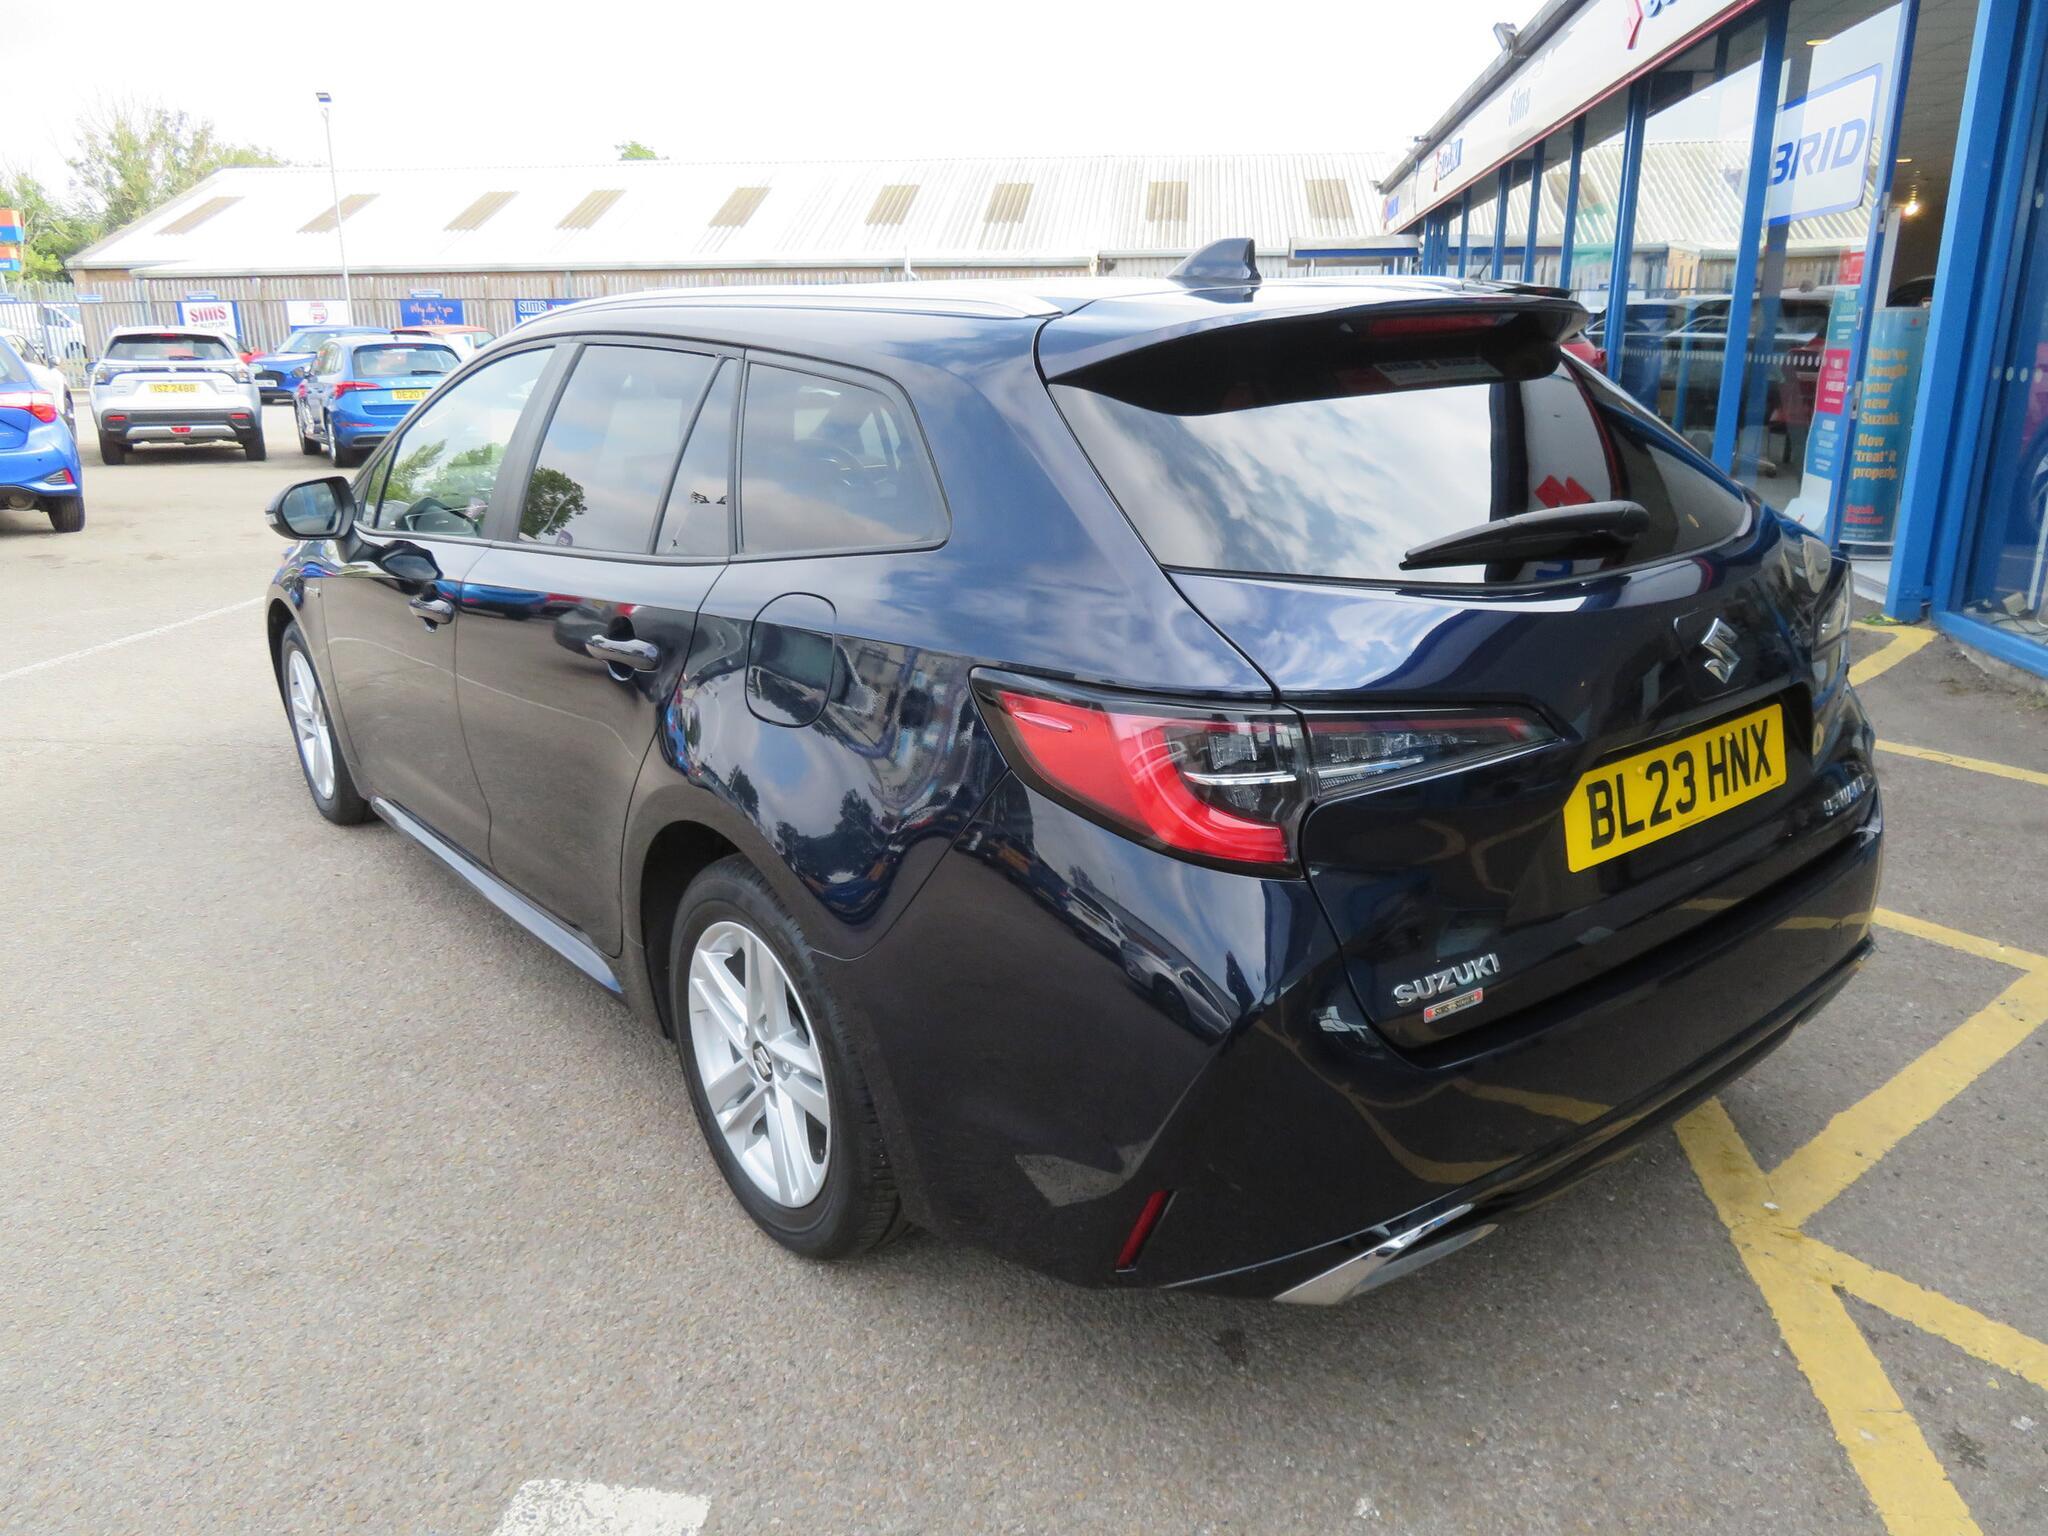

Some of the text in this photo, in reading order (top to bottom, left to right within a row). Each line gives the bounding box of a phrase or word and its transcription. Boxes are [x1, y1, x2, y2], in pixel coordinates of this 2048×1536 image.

[1858, 433, 1885, 446] Now
[1586, 719, 1772, 850] BL23 HNX
[1393, 953, 1500, 1007] SUZUKI
